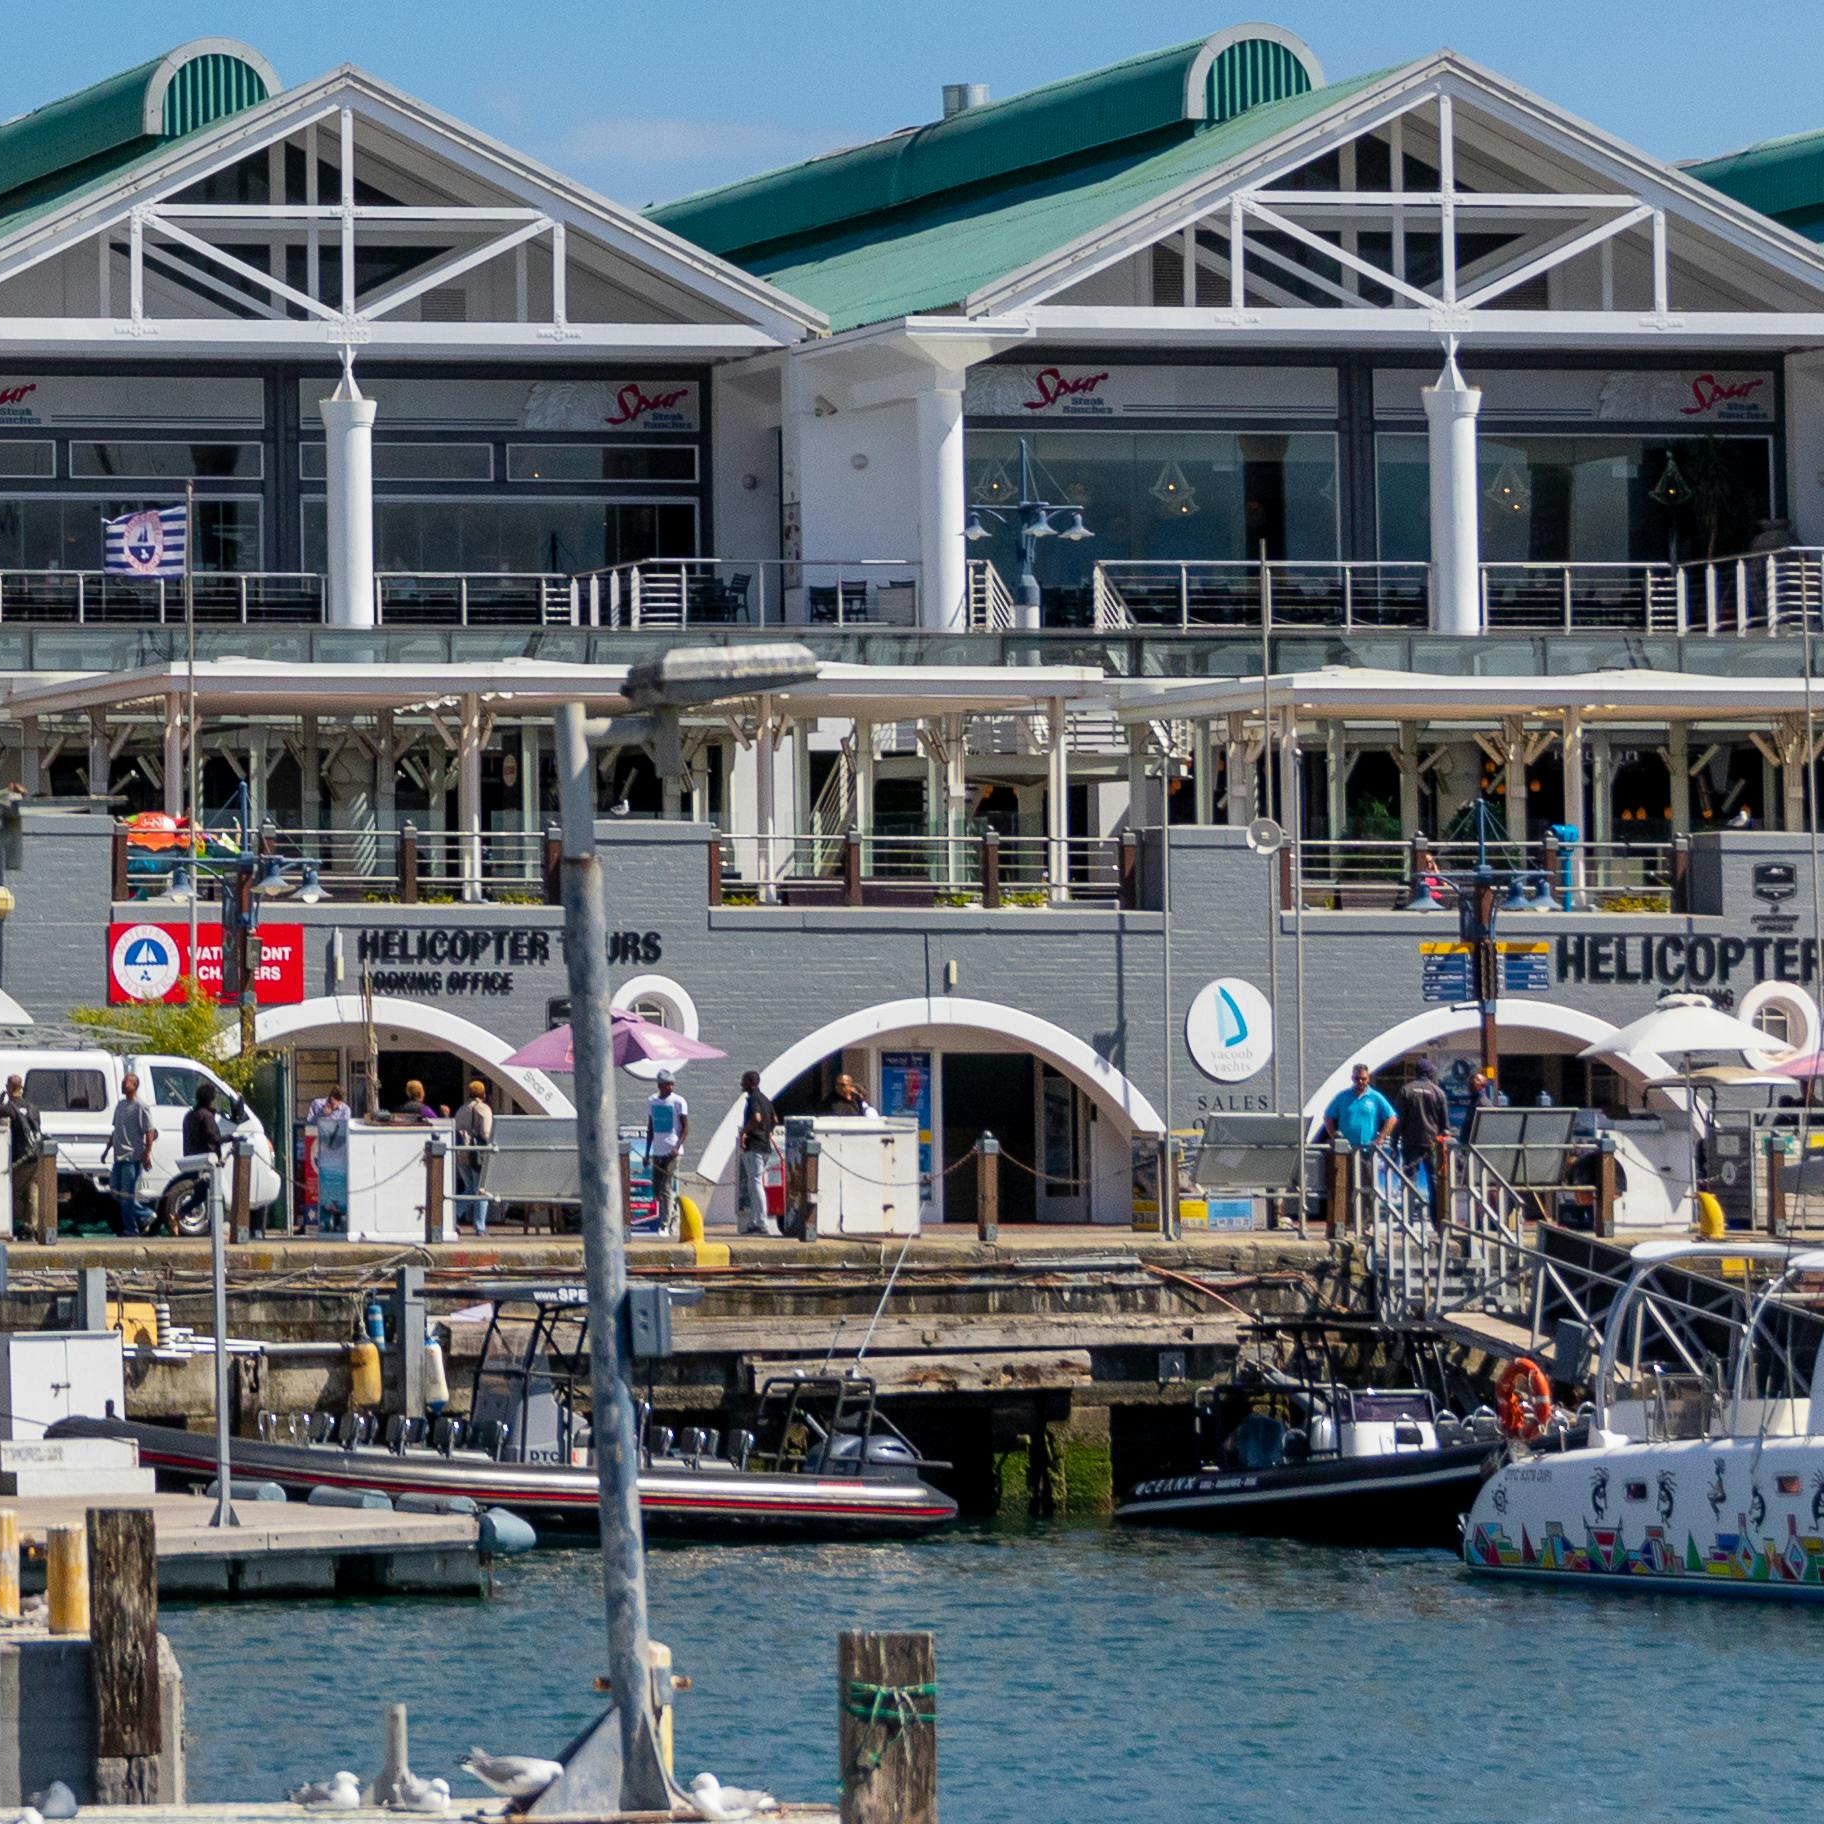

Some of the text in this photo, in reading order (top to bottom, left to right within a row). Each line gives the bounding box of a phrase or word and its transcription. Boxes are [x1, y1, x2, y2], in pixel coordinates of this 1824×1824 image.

[1023, 368, 1109, 409] Spur
[1680, 374, 1763, 414] Spur
[0, 408, 32, 416] Steak
[605, 384, 688, 425] Spur
[187, 946, 292, 961] WATONT
[358, 930, 663, 963] HELICOPTER URS
[199, 966, 282, 981] CHERS
[446, 972, 514, 993] OFFICE
[1211, 1049, 1253, 1061] yacoob
[1214, 1061, 1251, 1073] yachts
[1198, 1094, 1268, 1111] SALES
[530, 1450, 560, 1461] DTC
